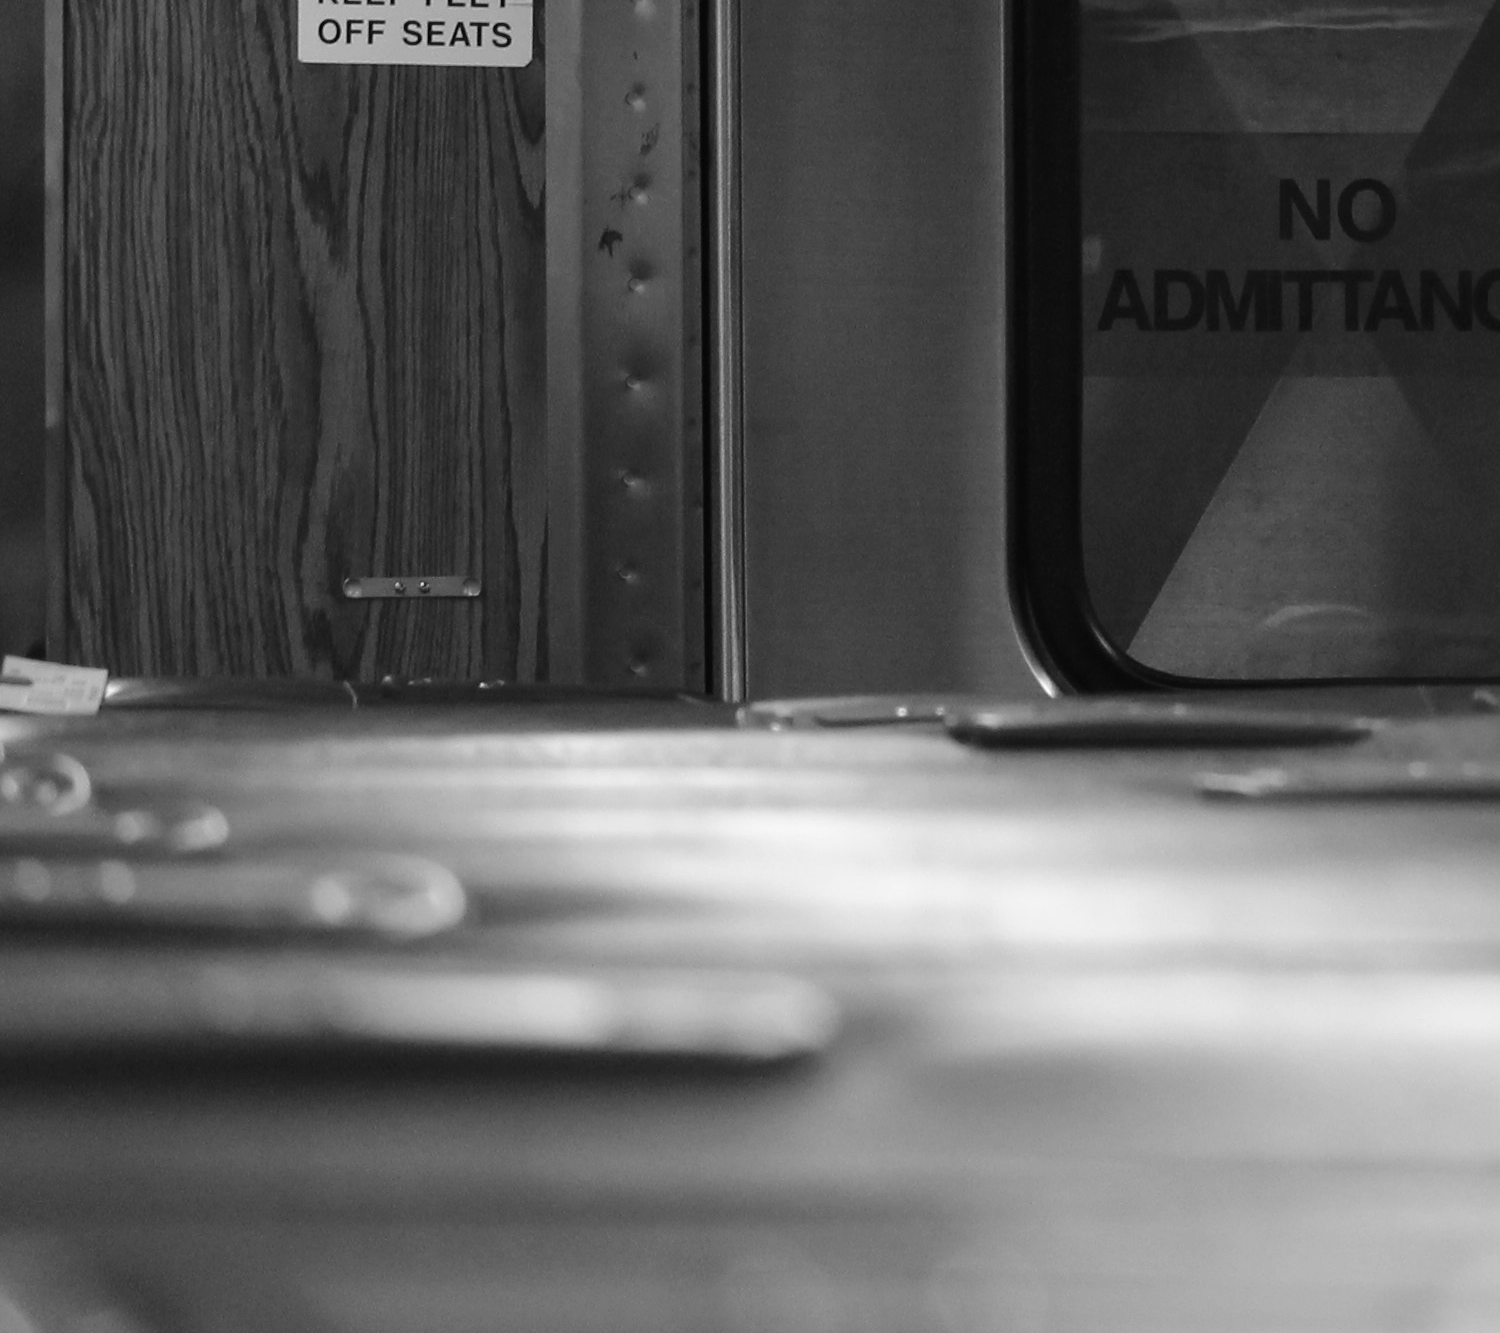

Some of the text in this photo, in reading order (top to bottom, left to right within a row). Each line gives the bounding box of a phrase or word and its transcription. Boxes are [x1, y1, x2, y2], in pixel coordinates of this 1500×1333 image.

[317, 18, 512, 49] OFF SEATS
[1278, 177, 1399, 245] NO
